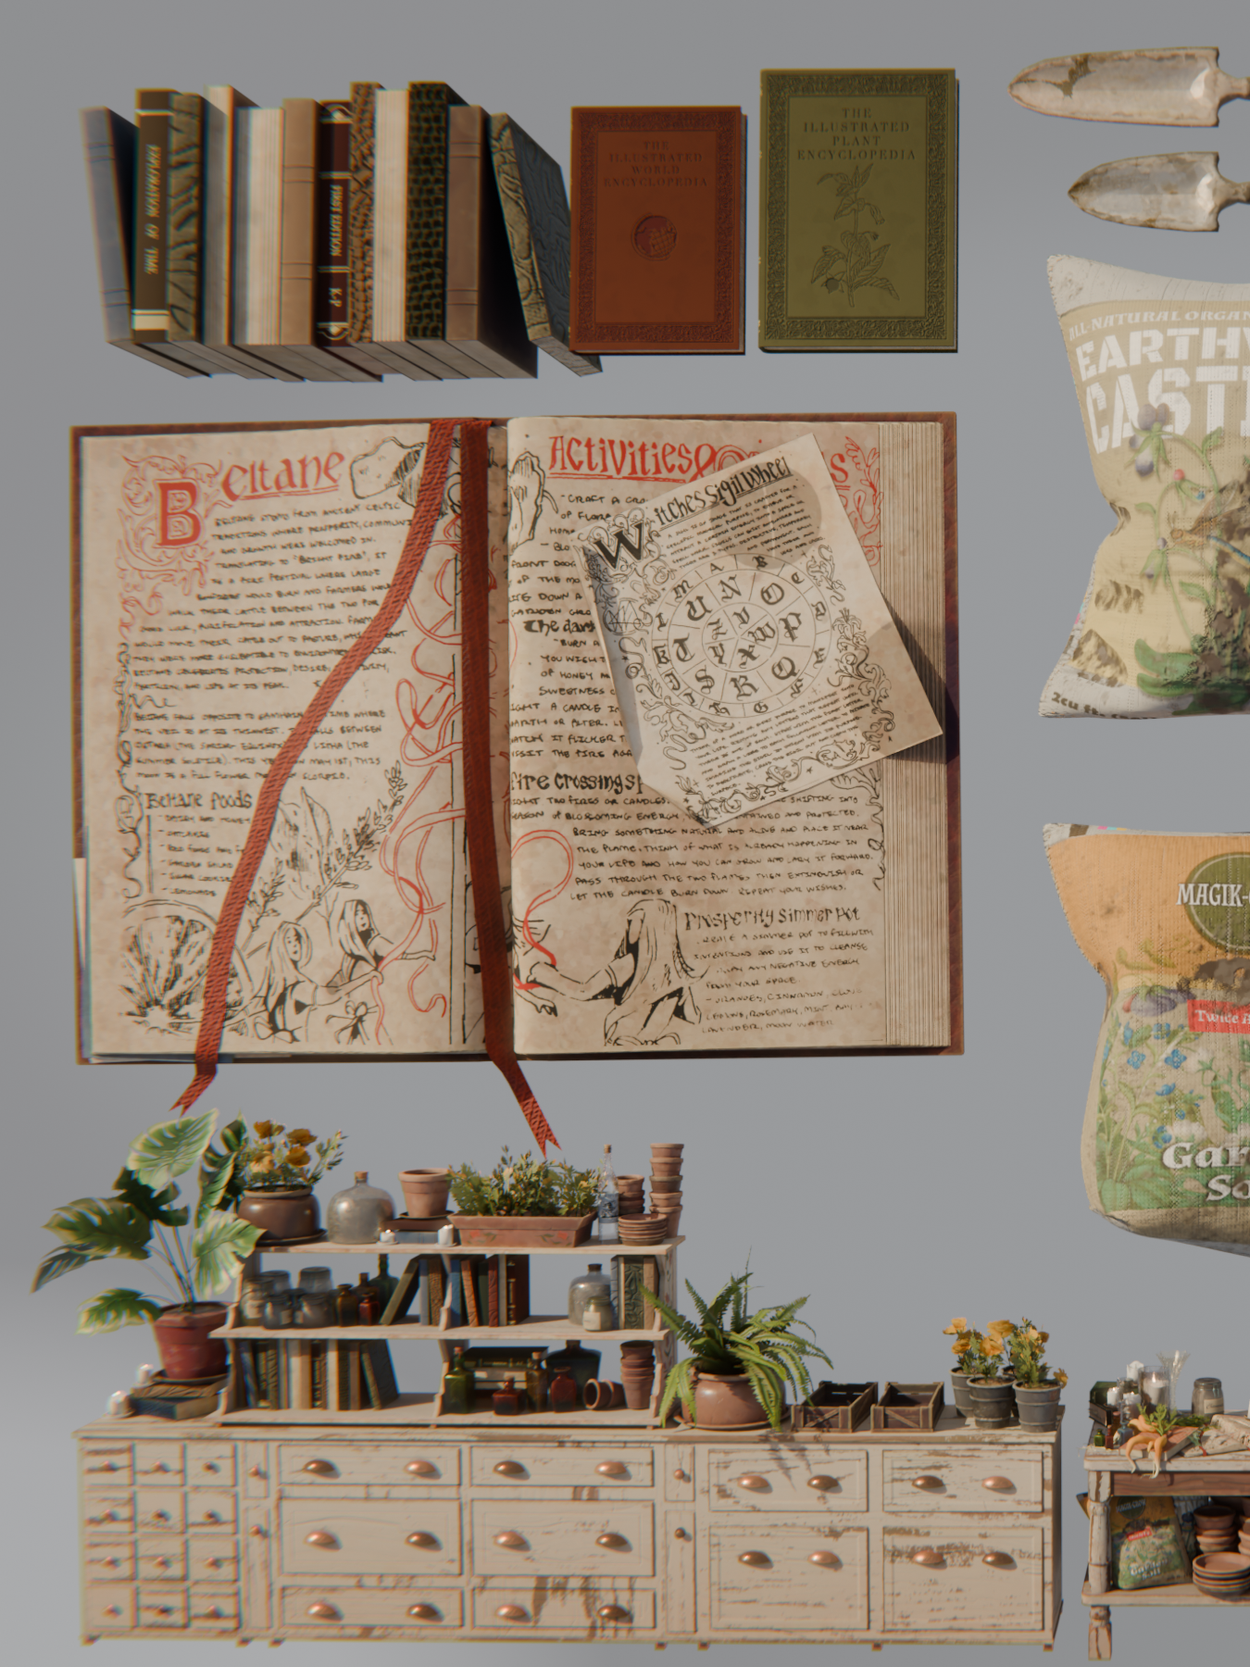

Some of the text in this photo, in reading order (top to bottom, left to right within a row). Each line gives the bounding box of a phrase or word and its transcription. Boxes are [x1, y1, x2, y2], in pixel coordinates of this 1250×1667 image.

[842, 107, 872, 119] THE
[803, 121, 911, 133] ILLUSTRATED
[642, 141, 669, 151] THE
[832, 135, 882, 147] PLANT
[608, 152, 703, 164] ILLUSTRATED
[796, 149, 917, 161] ENCYCLOPEDIA
[630, 164, 681, 175] WORLD
[603, 176, 709, 188] ENCYCLOPEDIA
[143, 143, 162, 275] EXPLORATION OF TIME
[329, 184, 344, 257] FIRST EDITION
[329, 287, 343, 308] K-P
[1194, 1008, 1241, 1026] Twice
